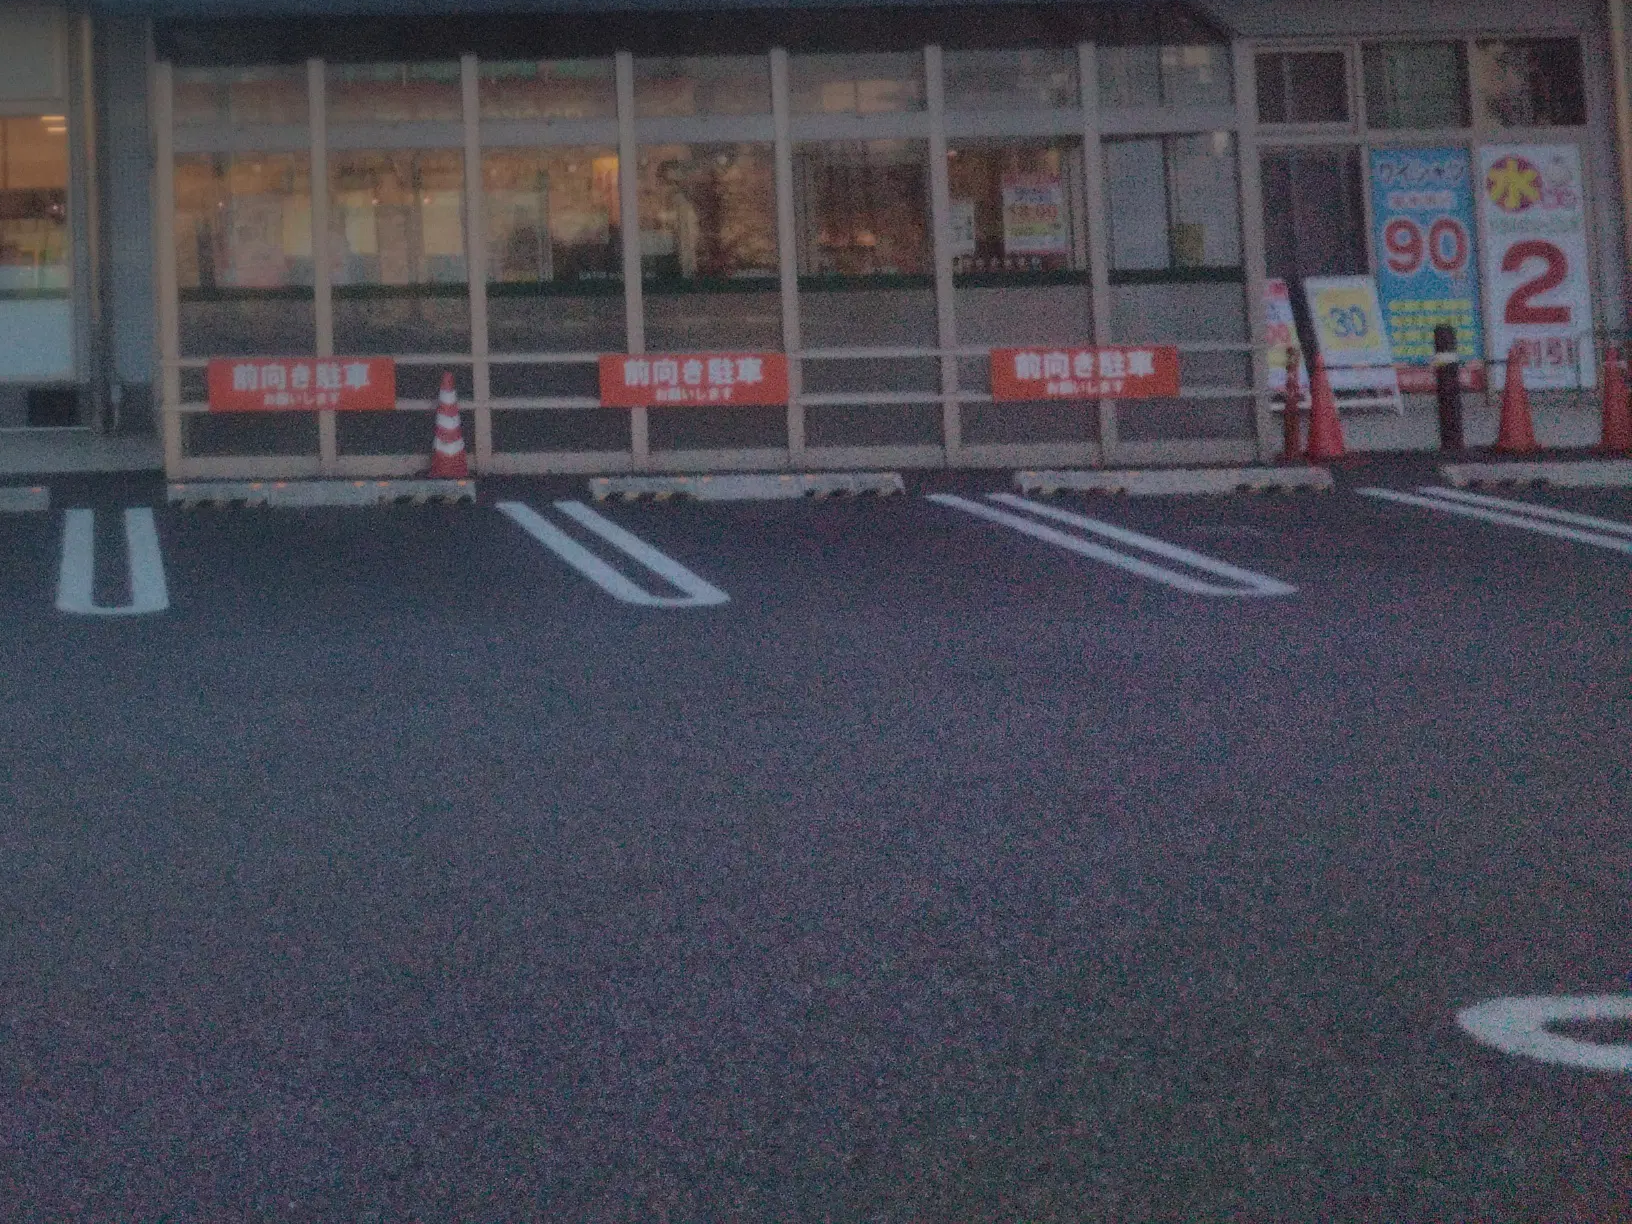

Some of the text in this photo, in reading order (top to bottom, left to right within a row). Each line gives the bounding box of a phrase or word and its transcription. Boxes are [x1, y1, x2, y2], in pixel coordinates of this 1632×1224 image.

[1384, 218, 1468, 274] 90
[1501, 240, 1571, 325] 2
[232, 362, 371, 391] 前向き駐車
[624, 357, 764, 387] 前向き駐車
[1014, 350, 1156, 380] 前向き駐車
[263, 391, 342, 406] お願いします
[655, 387, 735, 402] お願いします
[1046, 380, 1125, 394] お願いします
